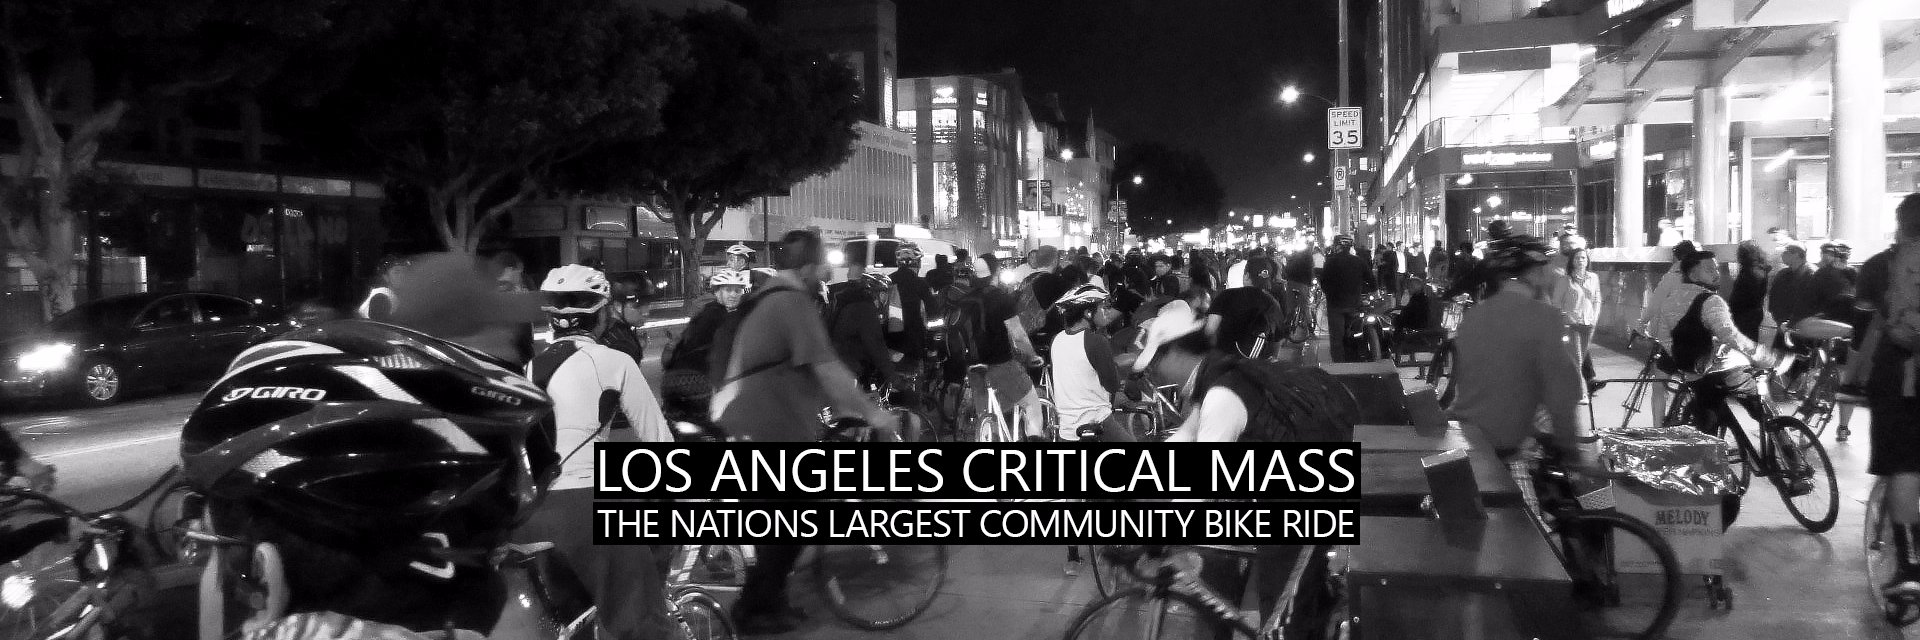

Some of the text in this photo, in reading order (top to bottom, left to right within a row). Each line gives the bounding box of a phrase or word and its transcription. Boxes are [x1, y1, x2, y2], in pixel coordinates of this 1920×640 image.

[1331, 110, 1359, 118] SPEED
[1333, 119, 1356, 127] LIMIT
[1332, 130, 1358, 145] 35
[251, 386, 327, 401] GIRO
[470, 386, 522, 406] GIRO
[1655, 509, 1710, 526] MELODY
